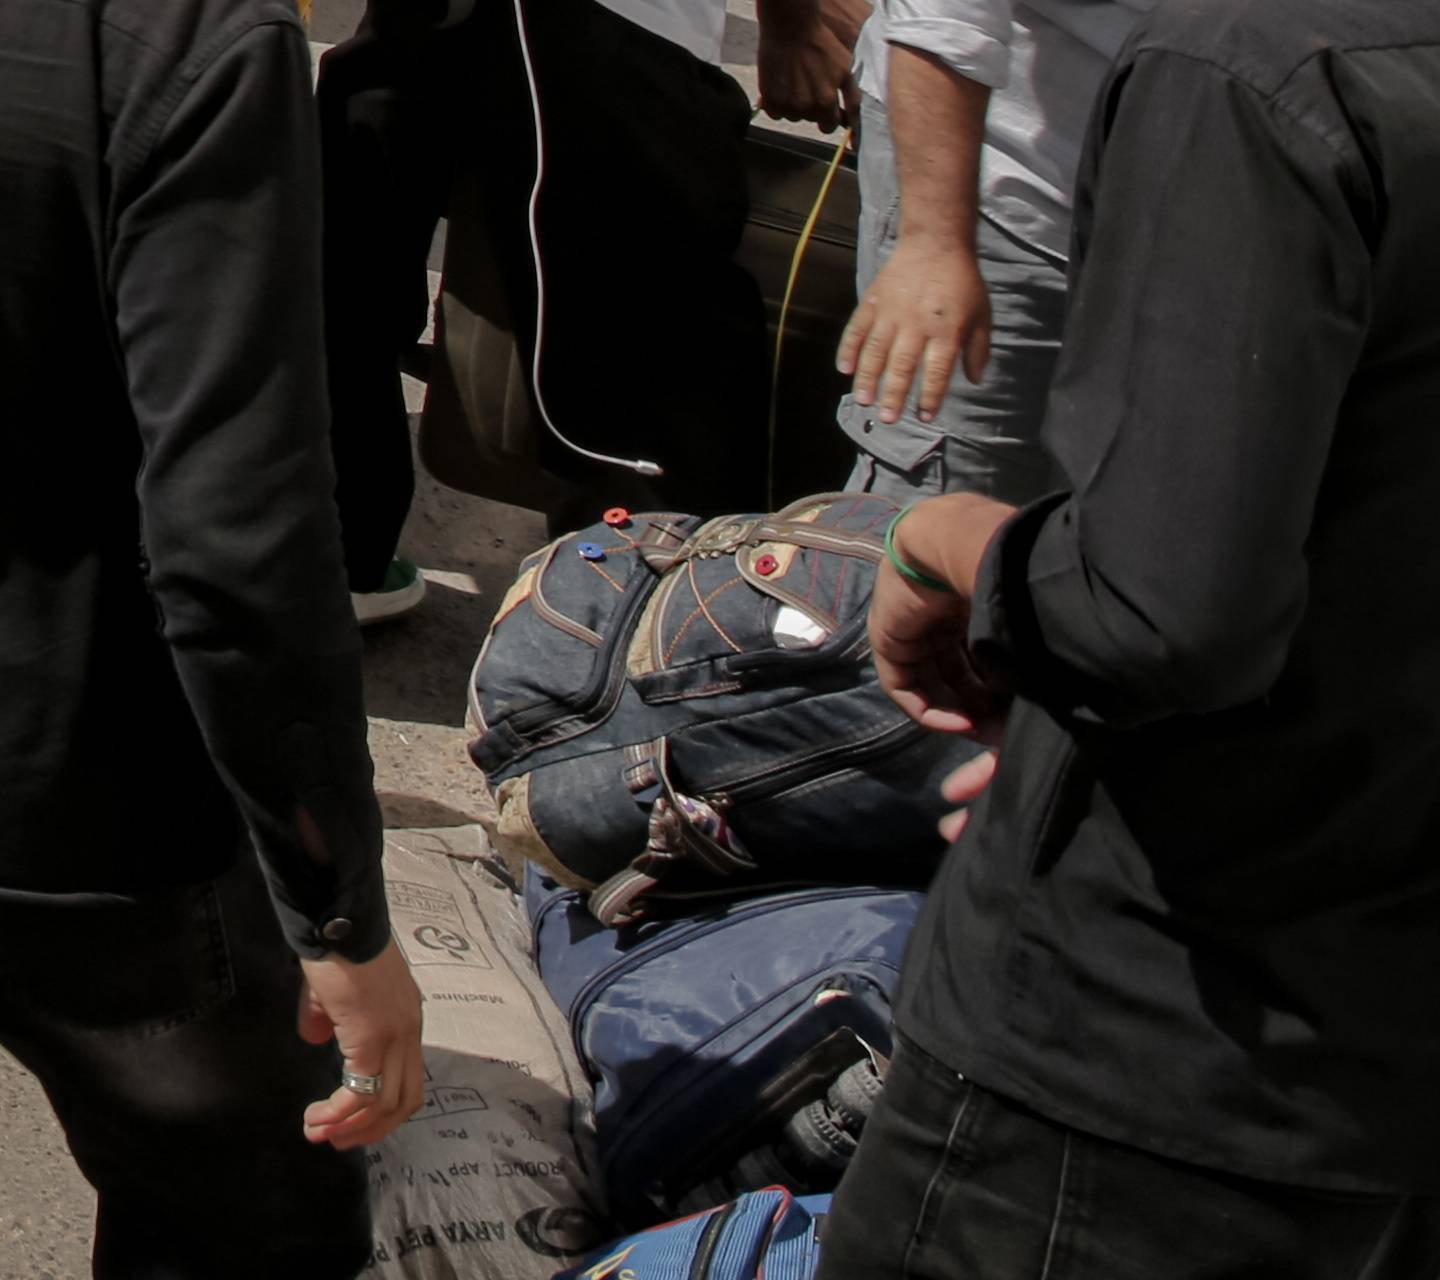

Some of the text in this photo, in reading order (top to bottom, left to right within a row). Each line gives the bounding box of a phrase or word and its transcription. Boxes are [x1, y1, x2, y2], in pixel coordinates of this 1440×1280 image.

[431, 992, 506, 1005] Machine
[493, 1159, 564, 1178] RODUCT
[394, 1224, 438, 1259] PET
[440, 1220, 506, 1245] ARYA
